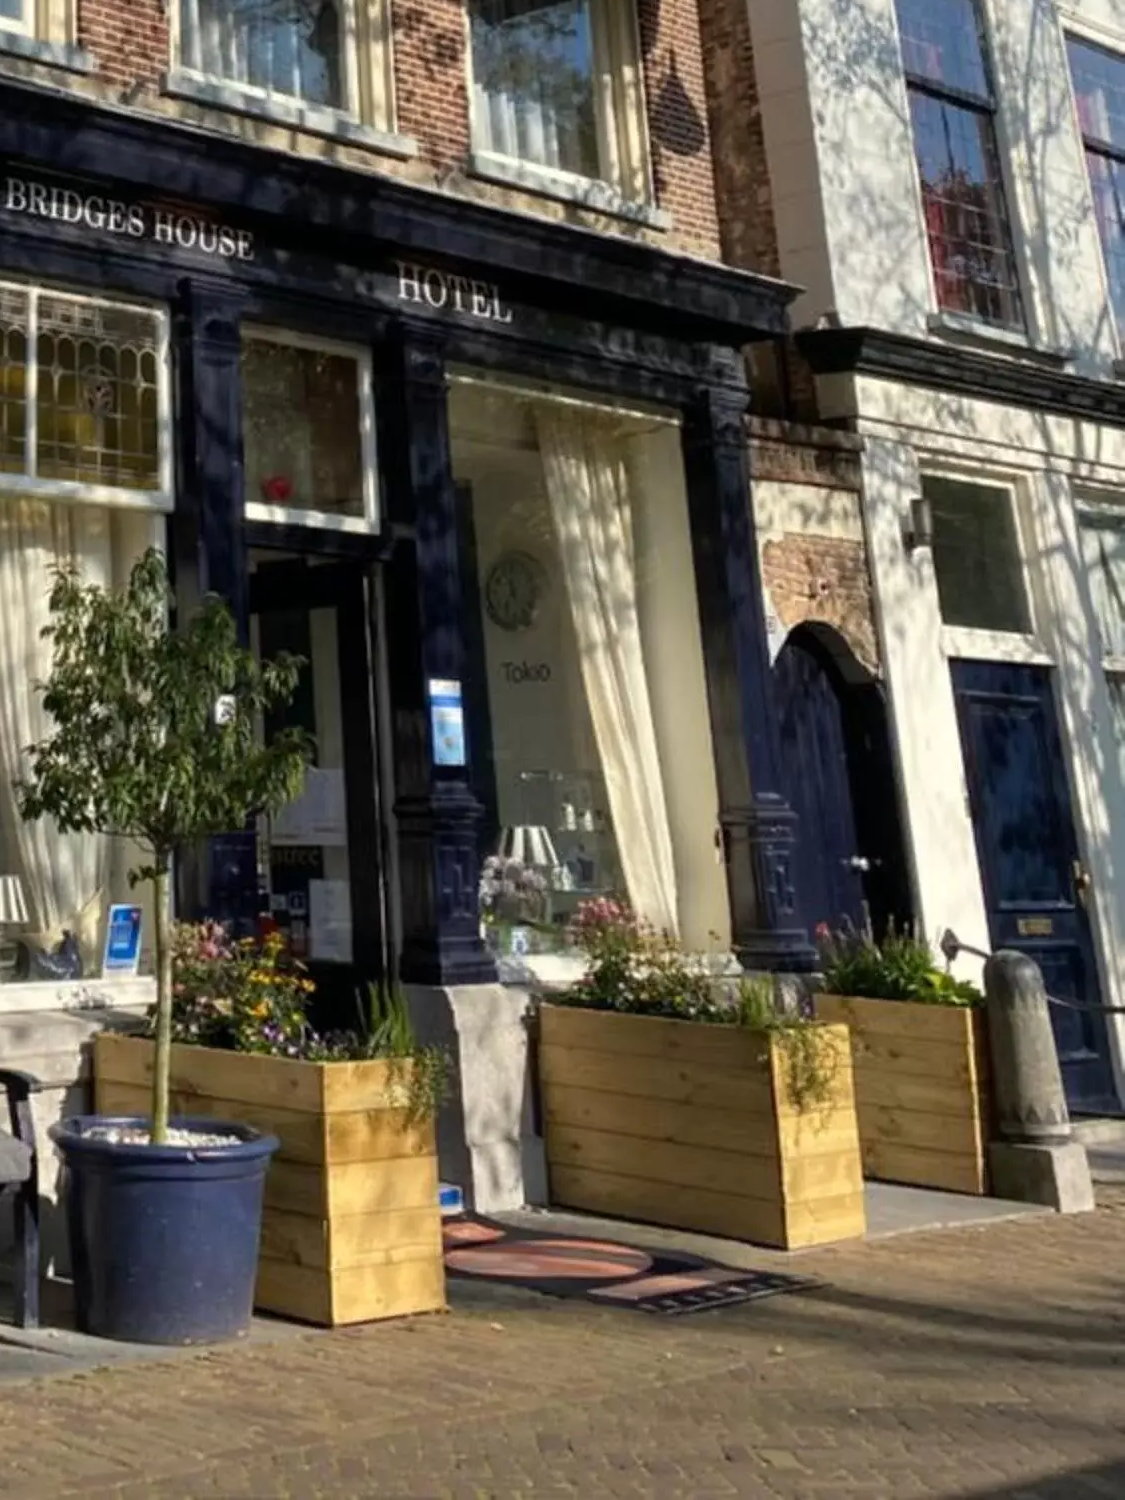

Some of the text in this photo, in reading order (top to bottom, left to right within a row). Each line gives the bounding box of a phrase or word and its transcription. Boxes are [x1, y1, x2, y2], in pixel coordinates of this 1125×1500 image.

[4, 176, 255, 261] BRIDGES HOUSE
[395, 260, 514, 324] HOTEL
